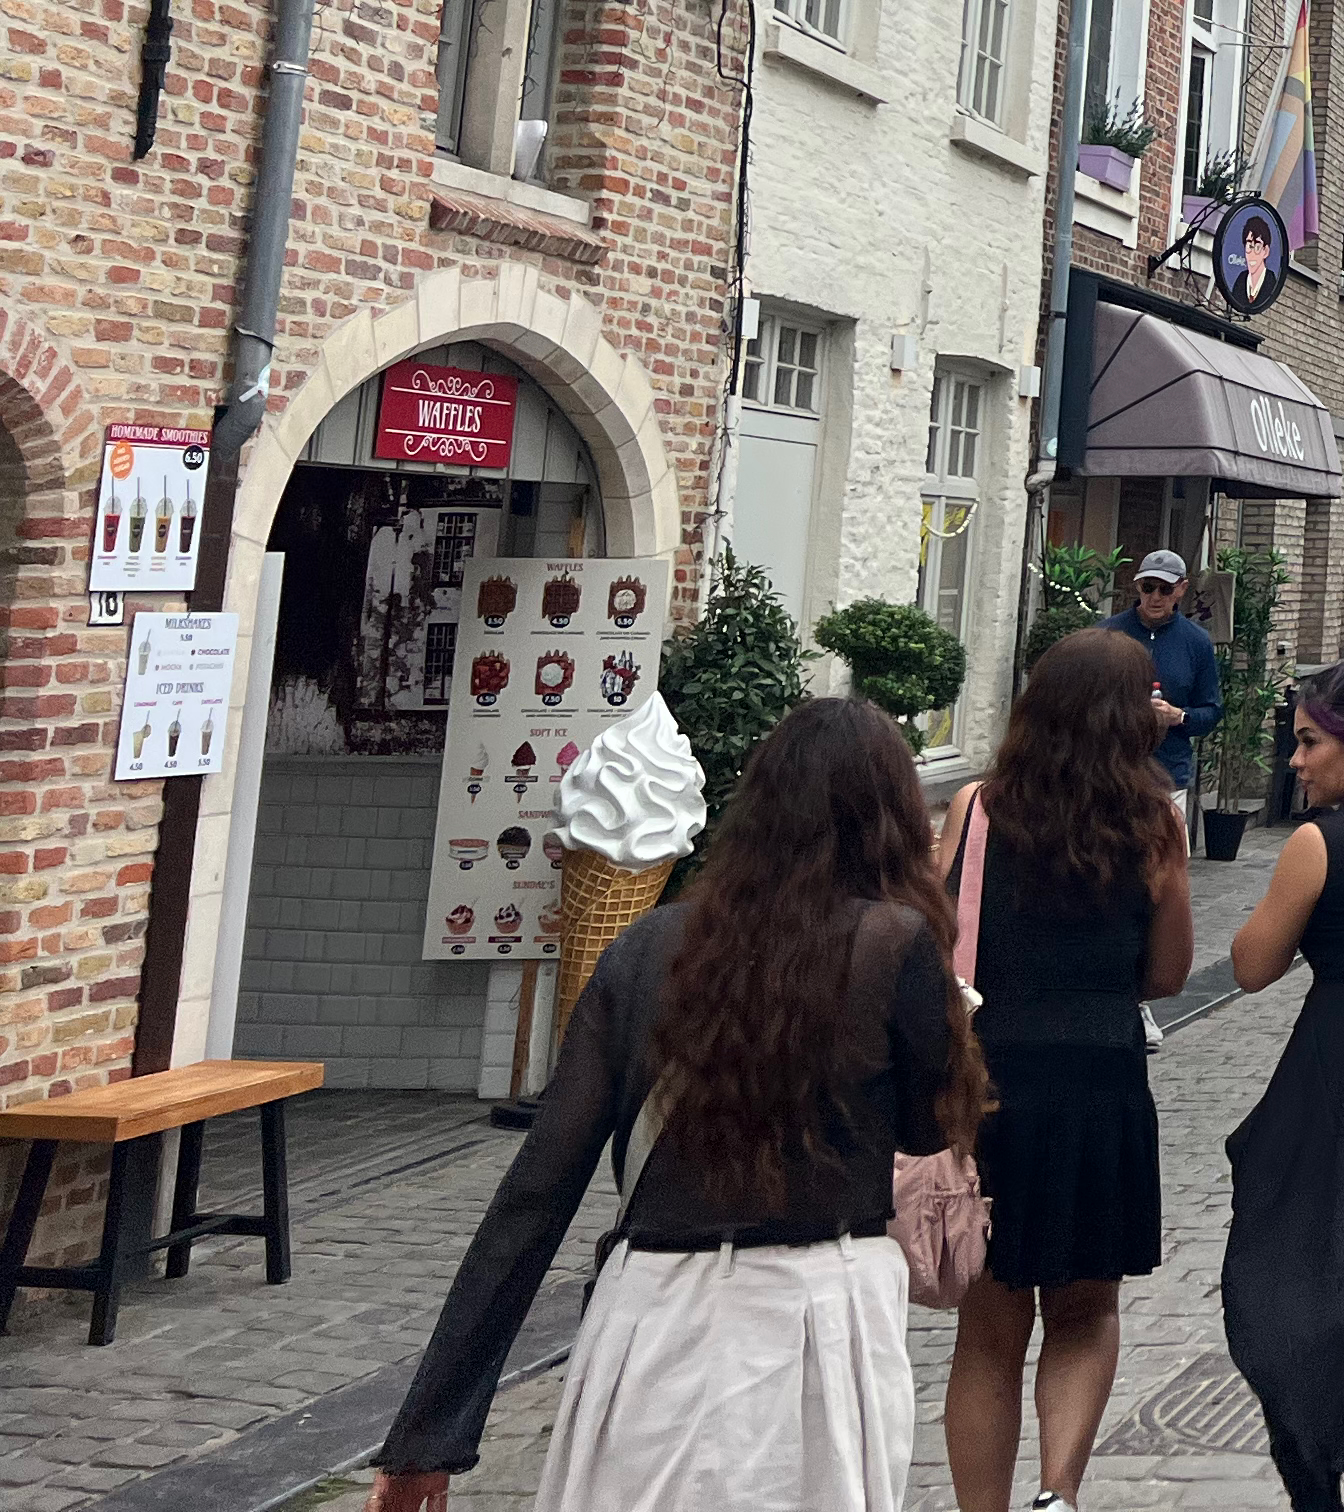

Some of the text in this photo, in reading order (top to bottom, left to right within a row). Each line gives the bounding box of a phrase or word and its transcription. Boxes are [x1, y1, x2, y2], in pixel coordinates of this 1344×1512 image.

[418, 399, 483, 433] WAFFLES
[1250, 395, 1305, 461] Olleke
[111, 424, 209, 444] HOMEMADE SMOOTHIES
[164, 618, 213, 630] MILKSHAKES
